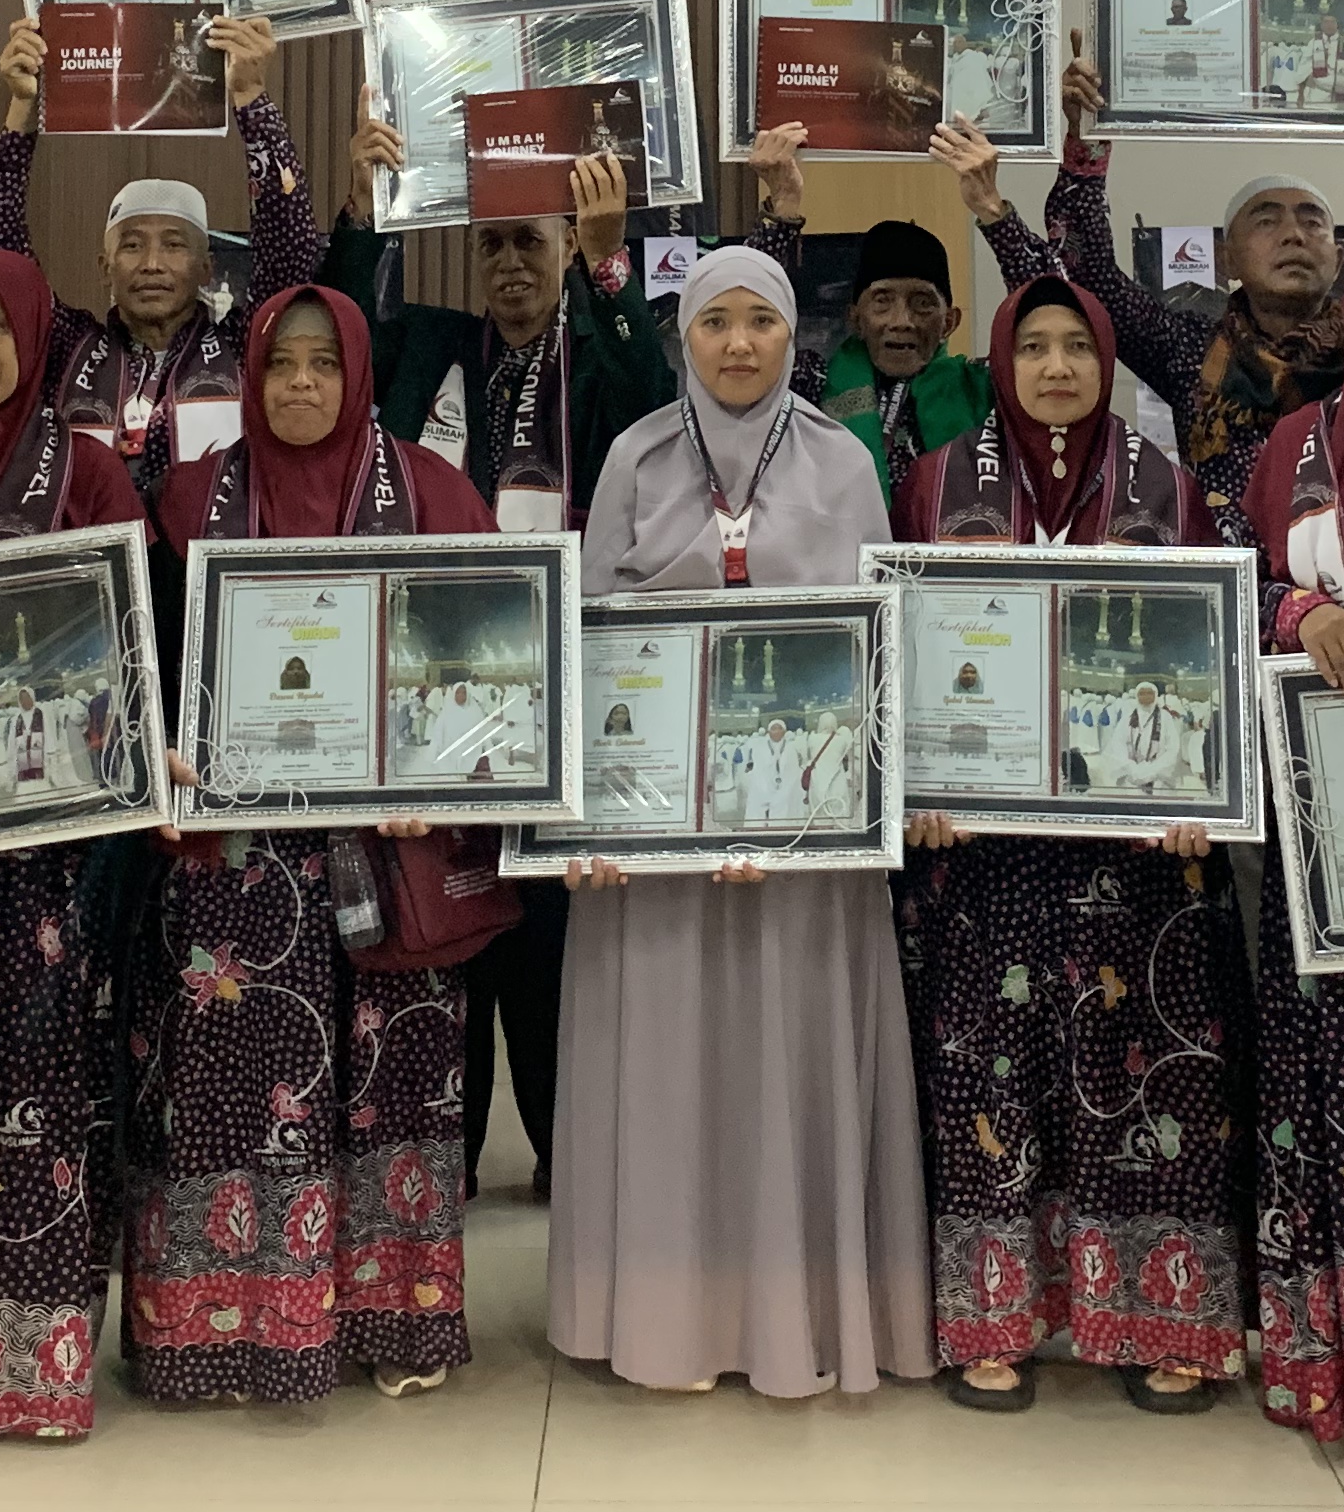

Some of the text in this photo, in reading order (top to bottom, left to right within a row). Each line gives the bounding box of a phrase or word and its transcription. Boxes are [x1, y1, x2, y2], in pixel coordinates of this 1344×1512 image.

[60, 47, 122, 59] UMRAH
[60, 58, 123, 70] JOURNEY
[777, 63, 839, 75] UMRAH
[777, 74, 839, 87] JOURNEY
[485, 132, 545, 147] UMRAH
[484, 143, 545, 158] JOURNEY
[650, 273, 687, 281] MUSLIMA
[424, 424, 467, 441] SLIMAH
[255, 614, 322, 633] Sertifikat
[927, 618, 994, 637] Sertifikat
